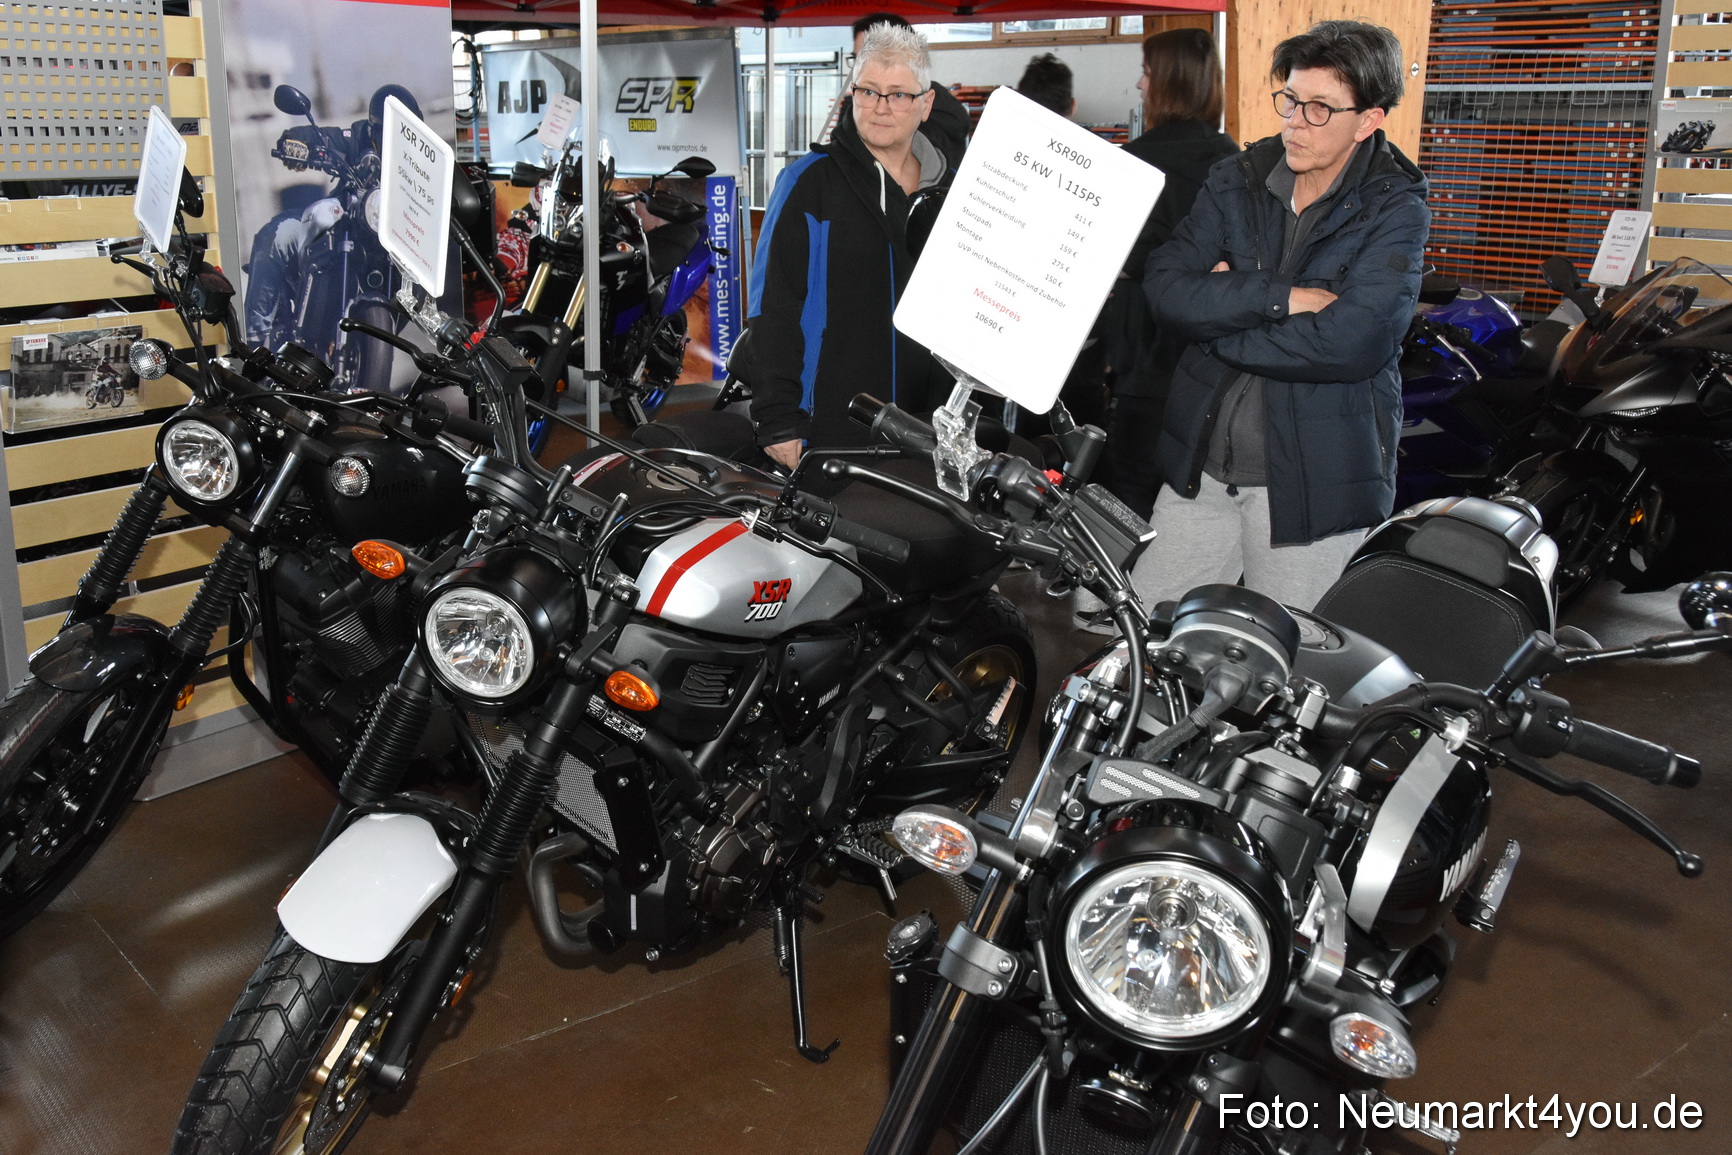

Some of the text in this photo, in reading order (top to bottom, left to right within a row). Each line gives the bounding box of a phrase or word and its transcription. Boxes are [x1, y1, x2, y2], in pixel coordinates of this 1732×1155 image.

[497, 79, 548, 114] AJP
[615, 76, 703, 114] SPR
[629, 119, 657, 131] ENDURO
[400, 121, 436, 164] XSR 700
[656, 142, 708, 153] www.ajpmotos.de
[1046, 137, 1092, 170] XSR900
[403, 151, 430, 183] X-Tribute
[982, 160, 1029, 192] Sitzabdeckung
[975, 176, 1017, 203] Kühlerschutz
[1013, 151, 1030, 167] 85
[1030, 160, 1054, 179] KW
[1064, 180, 1102, 208] 115PS
[417, 184, 426, 199] 75
[962, 206, 992, 229] Sturzpads
[968, 191, 1026, 229] Kühlerverkleidung
[1074, 213, 1087, 225] 411
[955, 221, 983, 242] Montage
[1067, 228, 1080, 240] 149
[1059, 243, 1073, 255] 159
[957, 241, 972, 253] UVP
[984, 256, 1026, 285] Nebenkosten
[1025, 282, 1039, 293] und
[1038, 289, 1067, 308] Zubehör
[1051, 258, 1065, 270] 275
[994, 280, 1012, 295] 11543
[1044, 273, 1058, 285] 150
[973, 287, 1021, 322] Messepreis
[975, 311, 998, 330] 10690
[372, 477, 427, 500] YAMAHA
[747, 578, 792, 605] XSR
[743, 601, 784, 623] 700
[817, 683, 841, 709] YAMAHA
